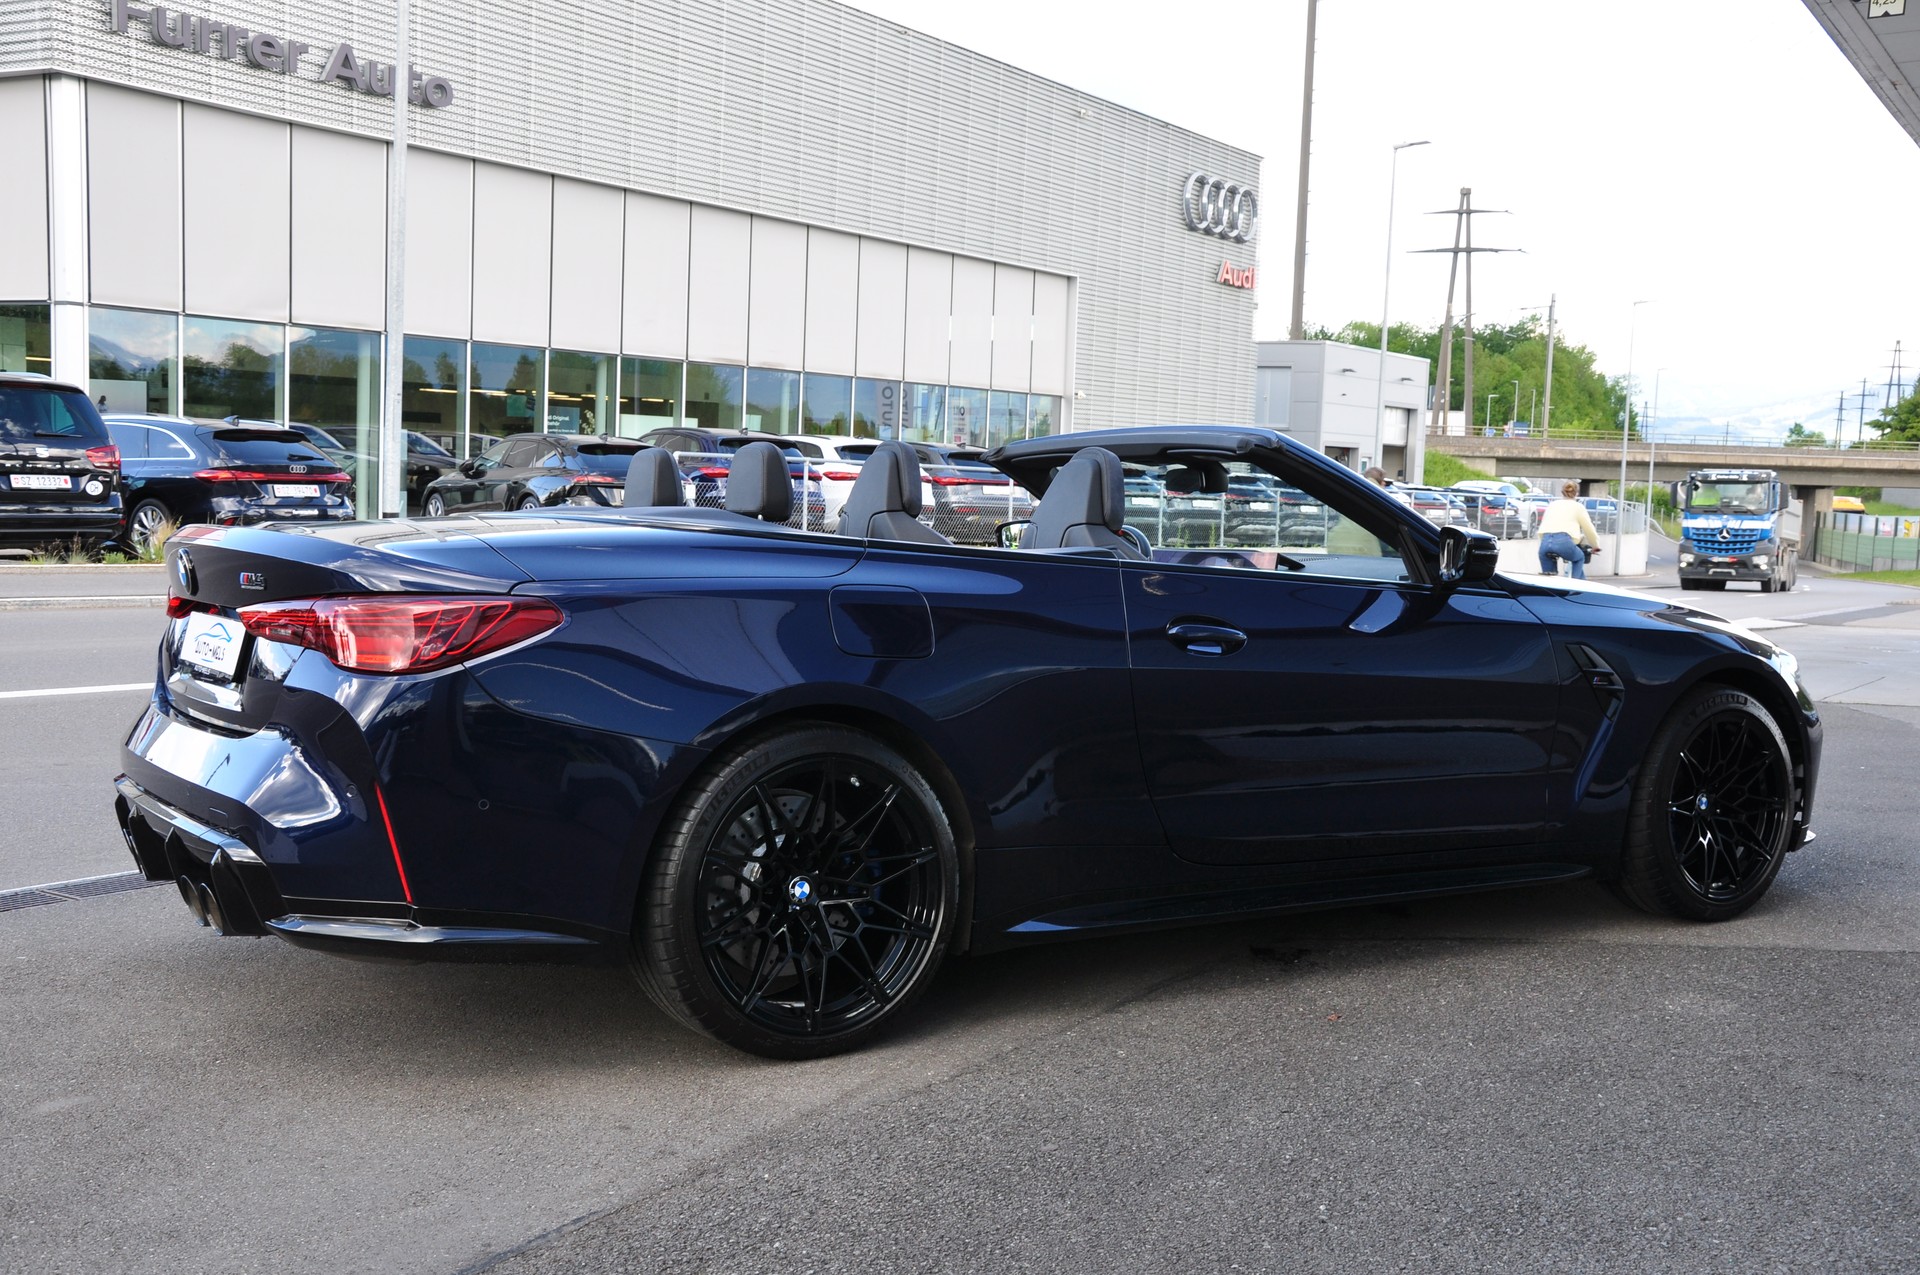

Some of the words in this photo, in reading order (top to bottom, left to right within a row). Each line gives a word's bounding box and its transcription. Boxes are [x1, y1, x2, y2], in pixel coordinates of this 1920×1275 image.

[111, 0, 309, 73] Furrer
[318, 42, 455, 108] Auto
[1216, 259, 1256, 289] Audi
